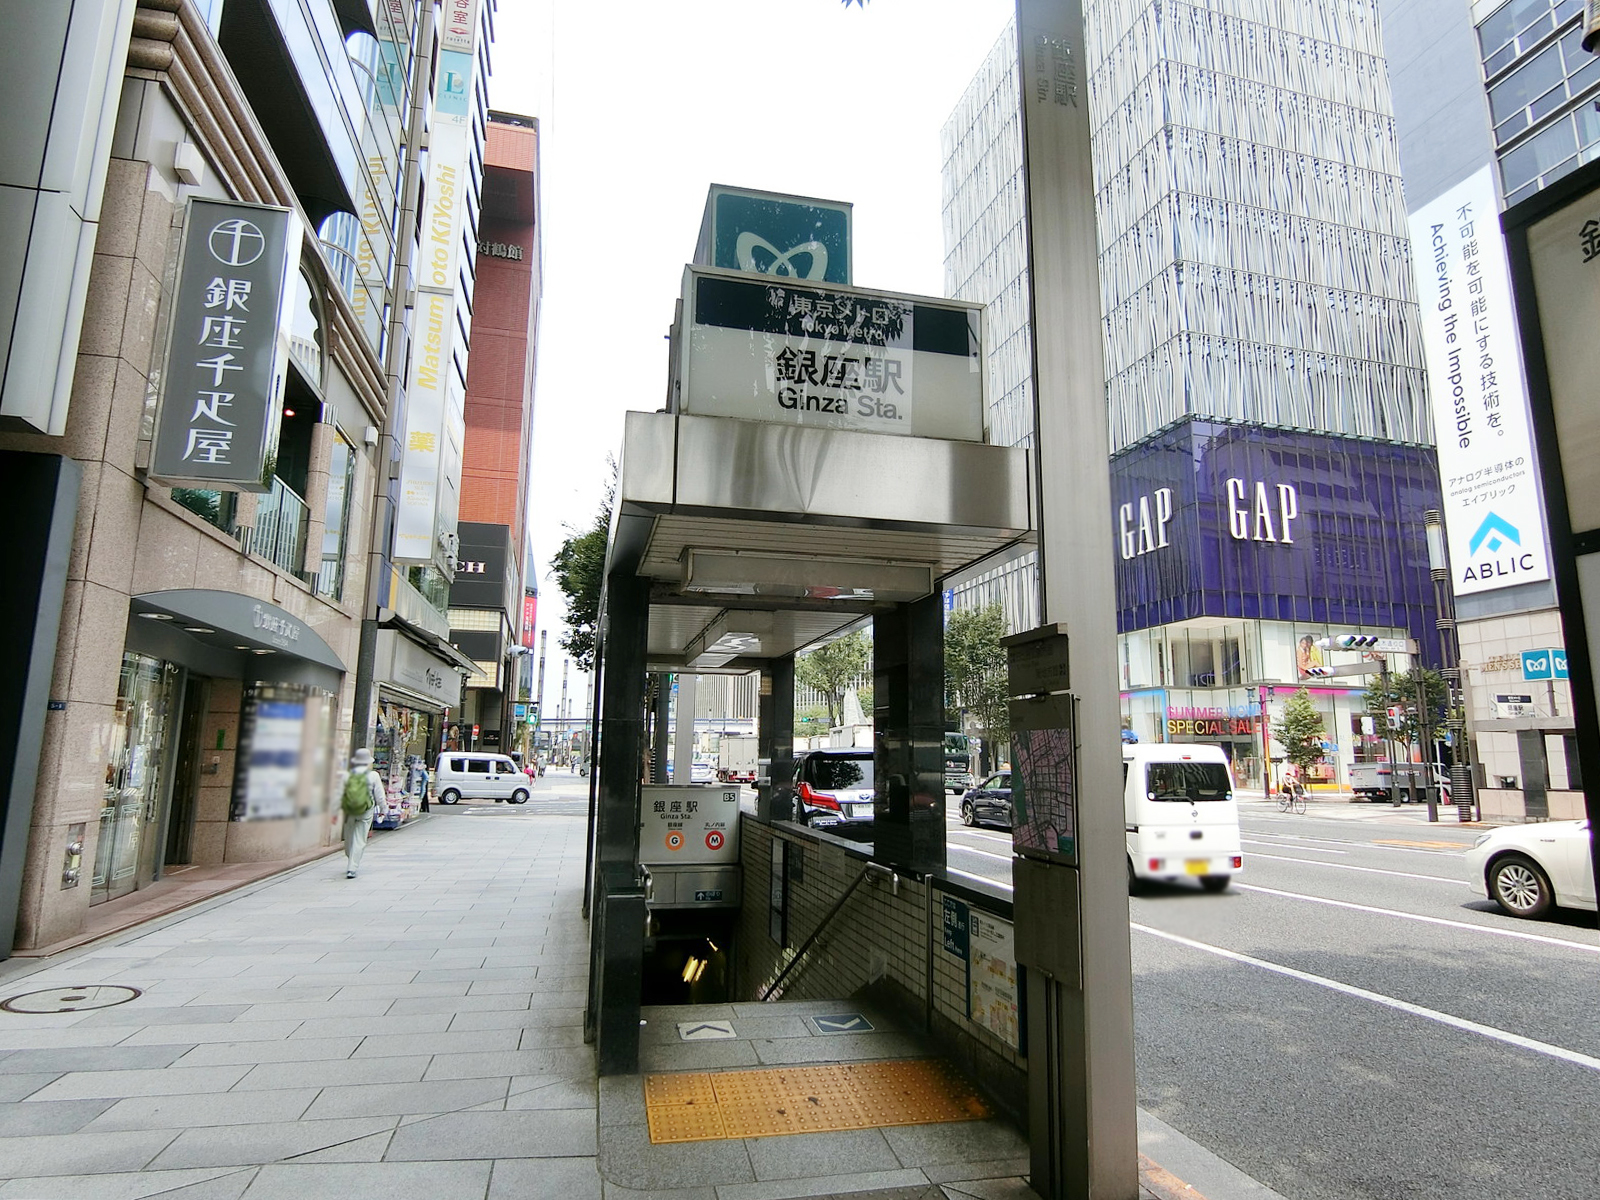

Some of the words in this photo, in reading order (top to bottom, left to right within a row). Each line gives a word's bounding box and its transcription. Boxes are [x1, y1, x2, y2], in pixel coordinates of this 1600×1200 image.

[452, 115, 466, 124] 4F
[431, 164, 457, 246] KiYoshi
[1431, 223, 1453, 312] Achieving
[799, 318, 840, 335] Tokyo
[844, 323, 883, 340] Metro
[1443, 313, 1458, 344] the
[1456, 202, 1504, 436] 不可能を可能にする技術を。
[182, 277, 252, 465] 銀座千疋屋
[775, 346, 904, 395] 銀座駅
[777, 387, 849, 415] Ginza
[857, 395, 903, 420] Sta.
[1447, 347, 1472, 449] Impossible
[1448, 457, 1525, 488] アナログ半導体の
[1450, 485, 1473, 497] analog
[1474, 470, 1526, 490] semiconductors
[1226, 478, 1298, 544] GAP
[1462, 484, 1516, 507] エイブリック
[1120, 487, 1173, 560] GAP
[1463, 554, 1534, 583] ABLIC
[1166, 706, 1223, 719] SUMMER
[1167, 720, 1226, 734] SPECIAL
[1229, 720, 1262, 734] SALE
[653, 801, 698, 813] 銀座駅
[724, 793, 735, 801] B5
